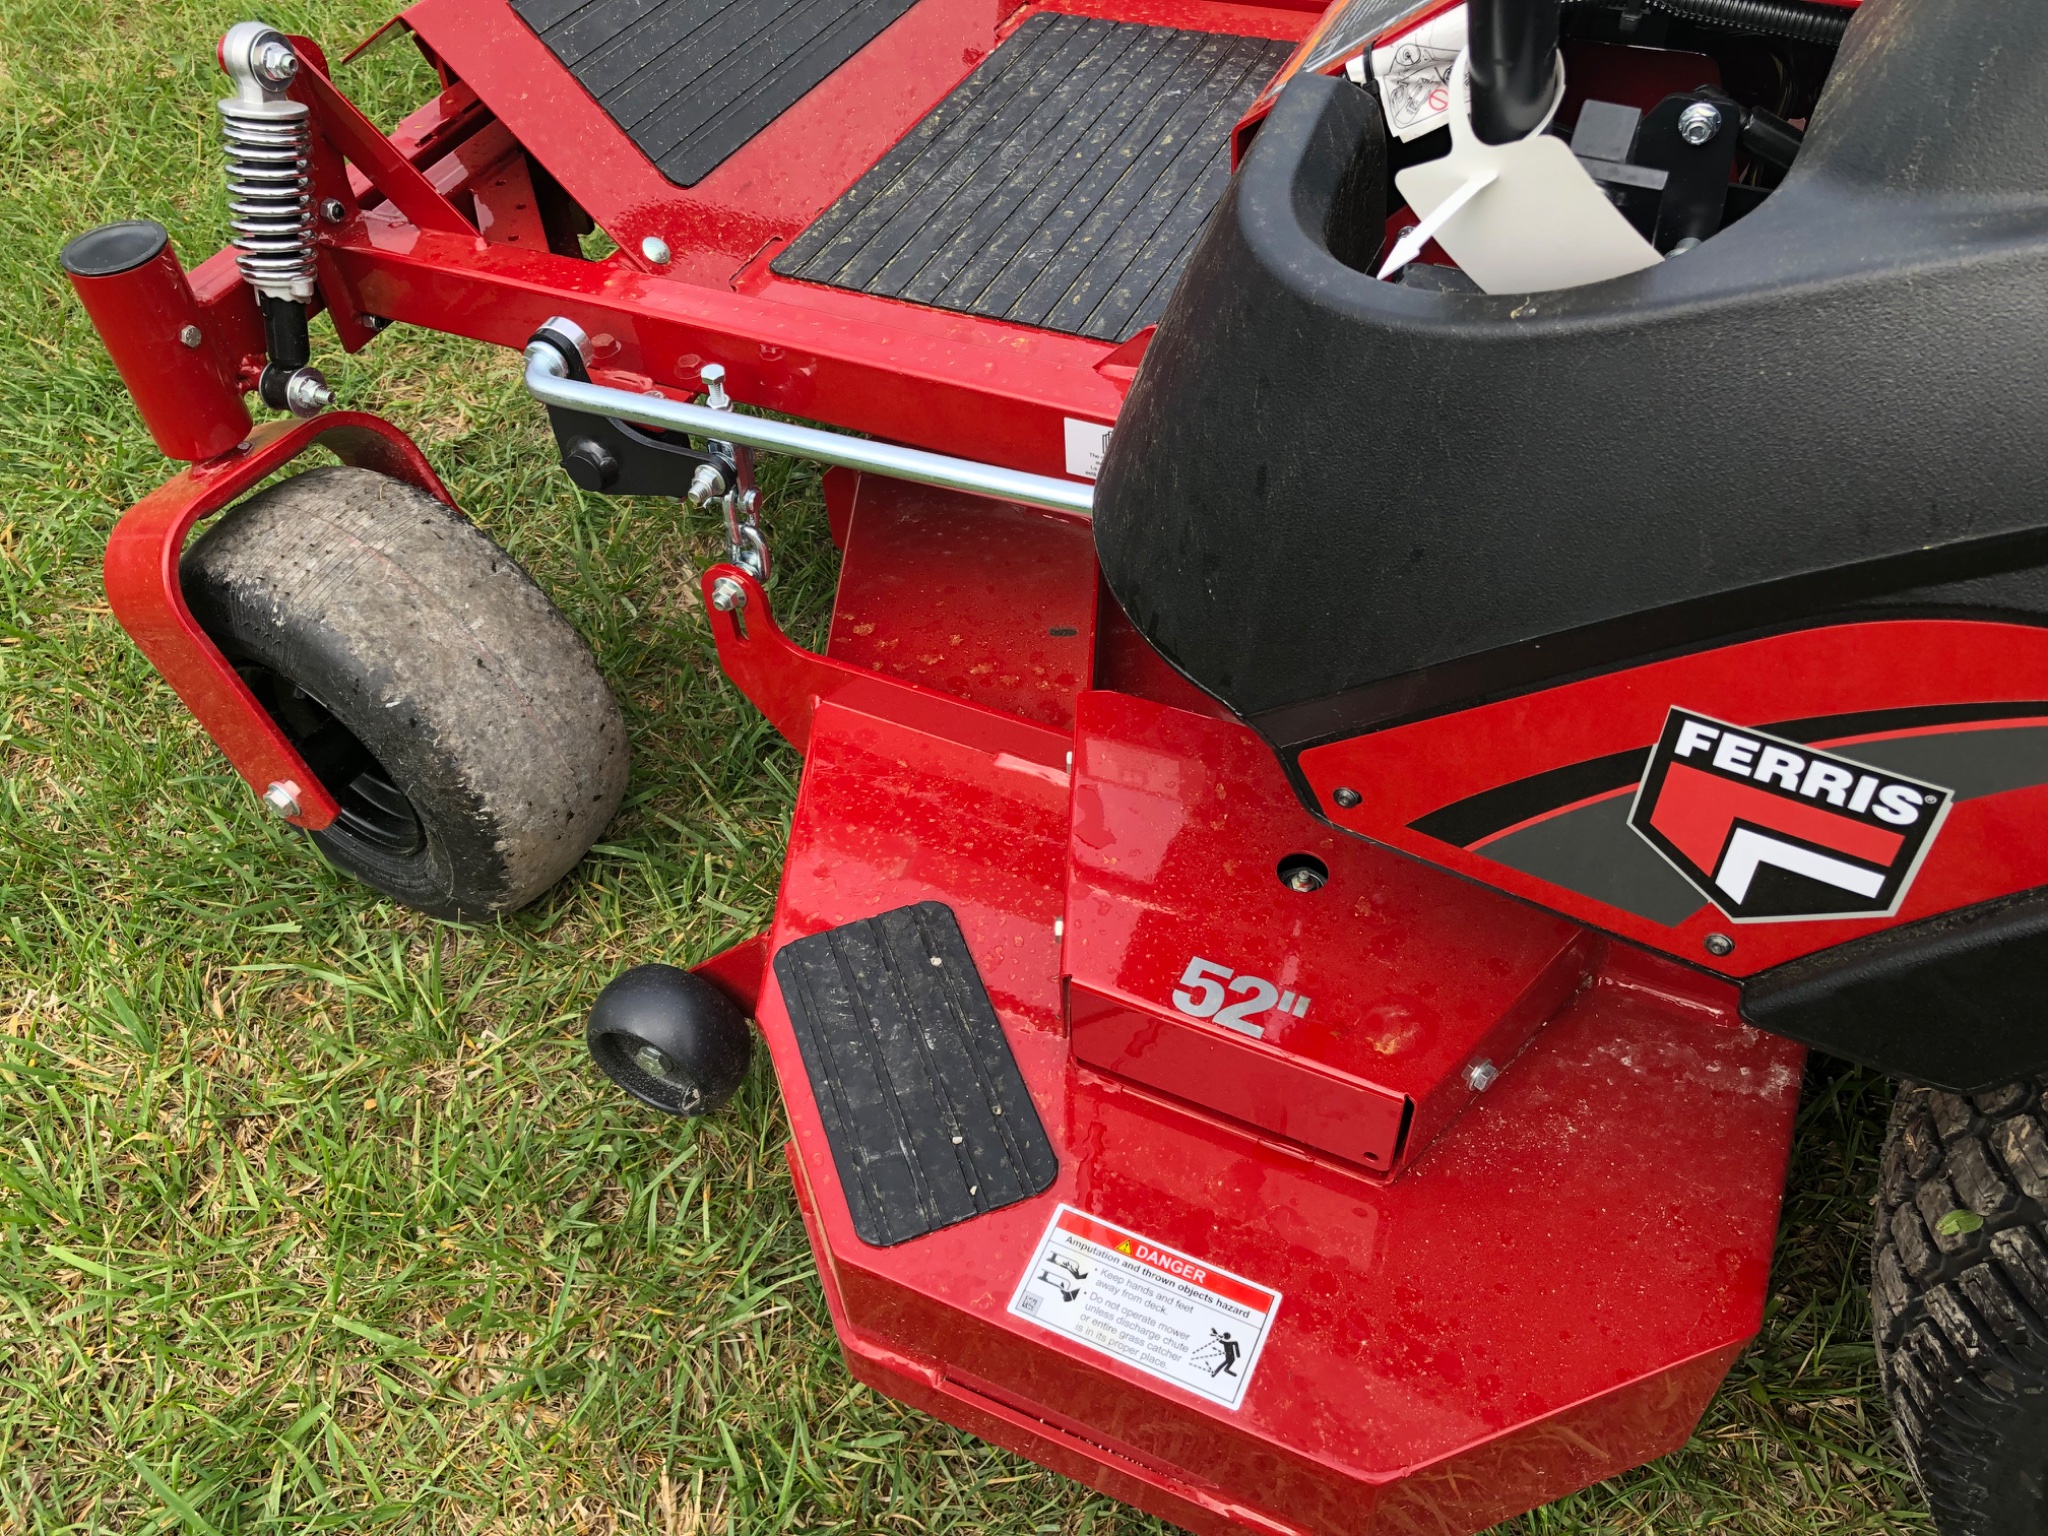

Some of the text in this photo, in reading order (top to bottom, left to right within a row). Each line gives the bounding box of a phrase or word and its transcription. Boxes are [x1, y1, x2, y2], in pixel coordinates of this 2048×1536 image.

[1172, 956, 1311, 1039] 52"
[1065, 1236, 1251, 1319] Amputation and thrown objects hazard
[1135, 1245, 1207, 1284] DANGER
[1095, 1279, 1168, 1315] away from deck.
[1100, 1268, 1194, 1314] Keep hands and feet
[1080, 1313, 1183, 1362] or entire grass catcher
[1084, 1303, 1189, 1353] unless discharge chute
[1089, 1291, 1191, 1341] Do not operate mower
[1075, 1322, 1168, 1369] is in its proper place.
